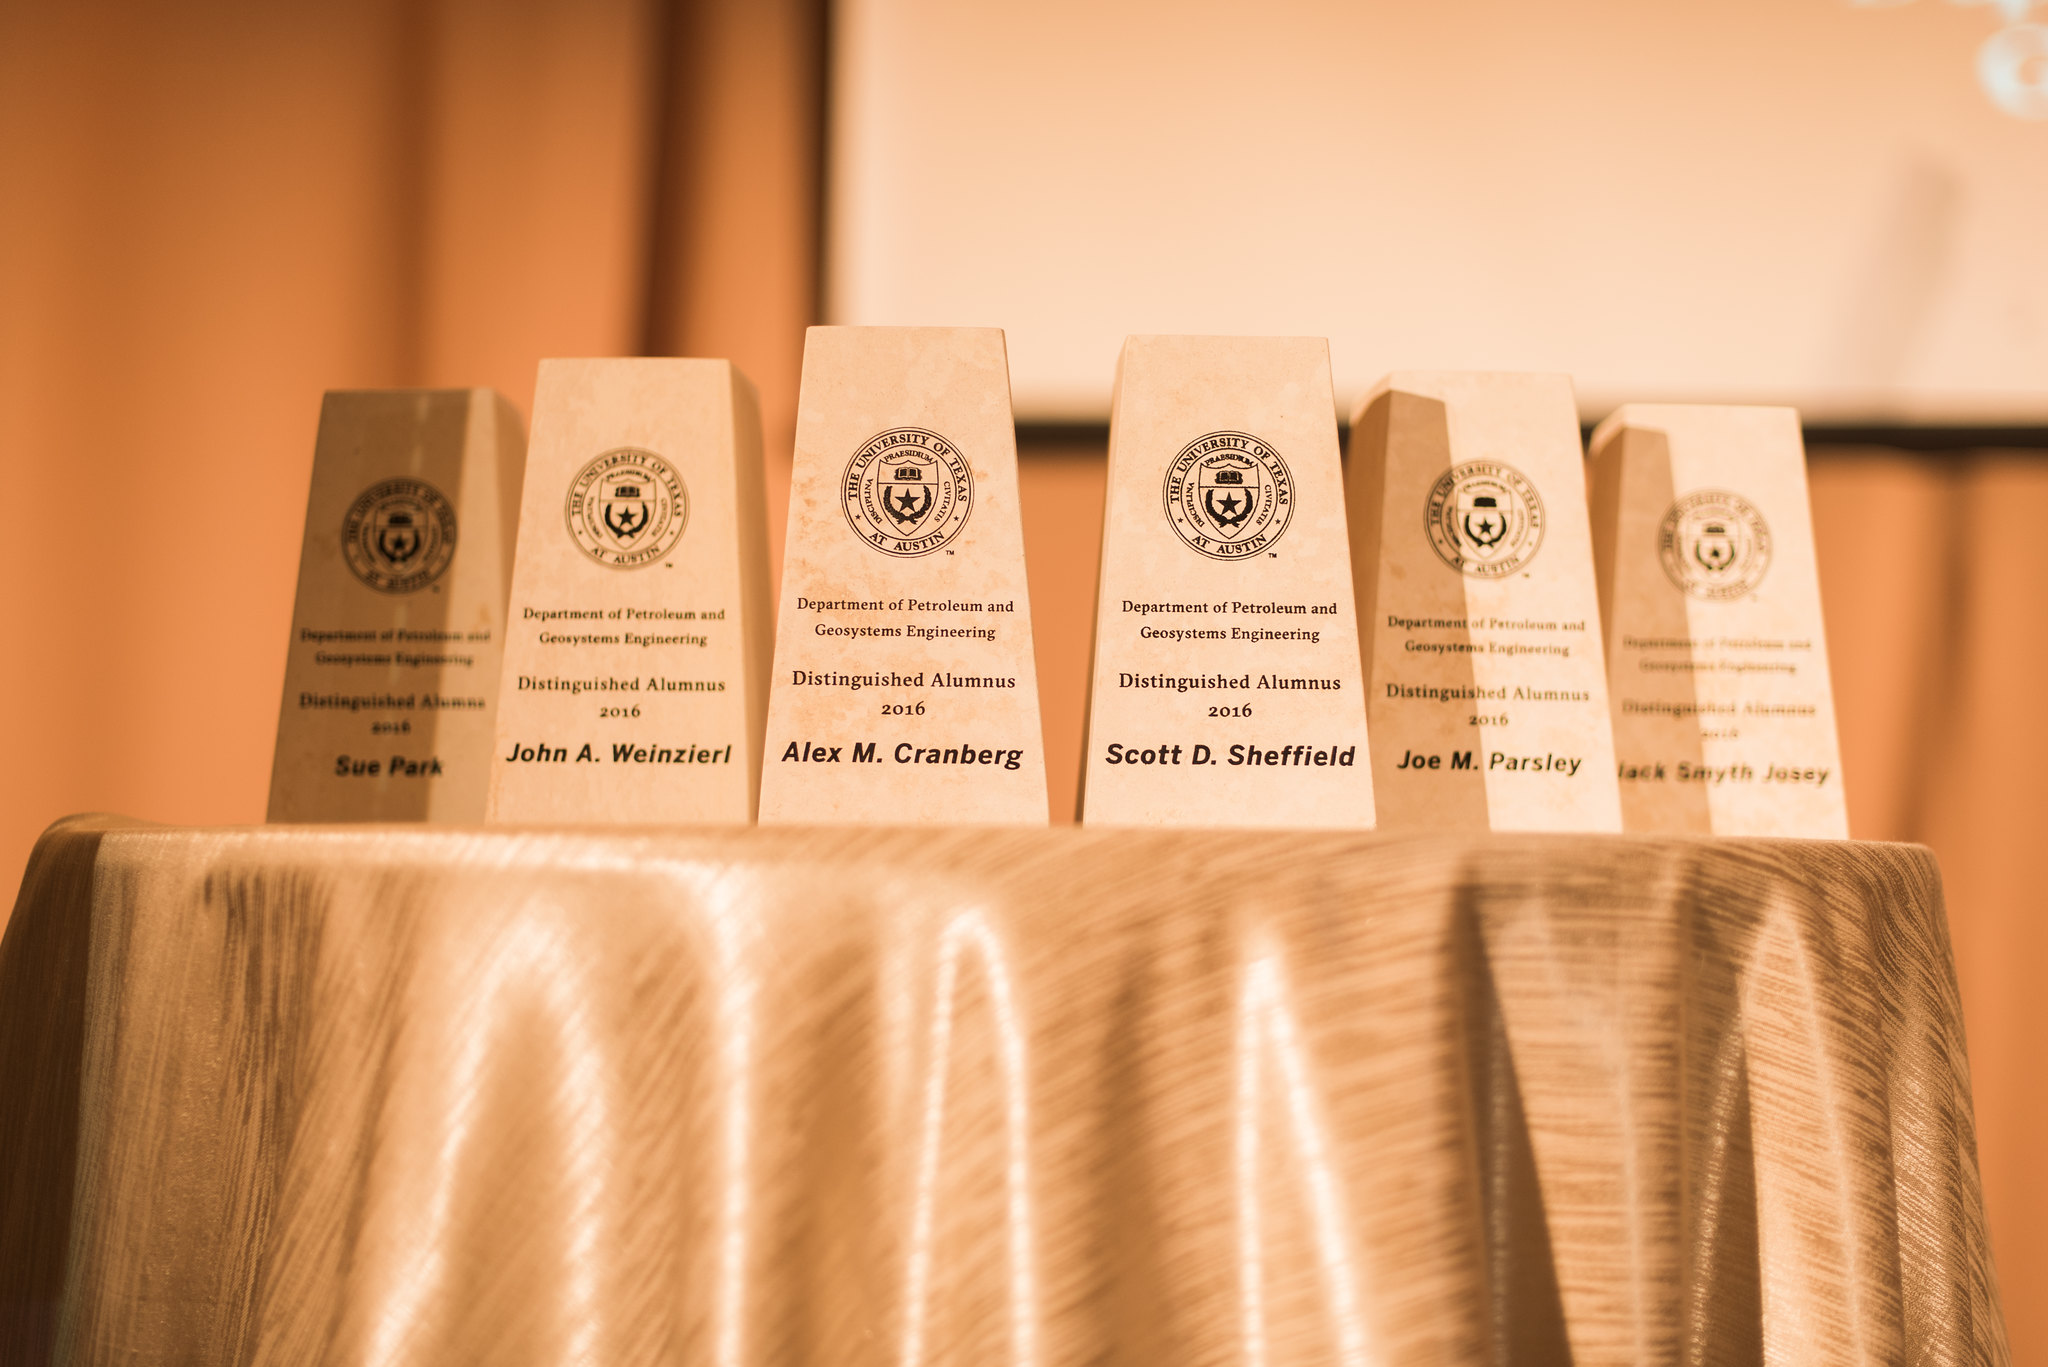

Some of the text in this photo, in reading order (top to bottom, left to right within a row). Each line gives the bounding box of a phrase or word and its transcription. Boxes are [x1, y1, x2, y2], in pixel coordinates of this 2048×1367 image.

[884, 450, 934, 464] PRAESIDIUM
[848, 434, 967, 502] THE UNIVERSITY OF TEXAS
[1170, 438, 1288, 505] THE UNIVERSITY OF TEXAS
[864, 478, 882, 524] DISCIPLINA
[934, 481, 951, 522] CIVITATIS
[1186, 482, 1205, 528] DISCIPLINA
[1256, 484, 1272, 526] CIVITATIS
[869, 531, 944, 551] AT AUSTIN
[1192, 534, 1267, 554] AT AUSTIN
[797, 597, 1014, 613] Department of Petroleum and
[1122, 600, 1338, 616] Department of Petroleum and
[524, 607, 725, 623] Department of Petroleum and
[1387, 616, 1586, 632] Department of Petroleum and
[539, 632, 708, 647] Geosystems Engineering
[814, 624, 996, 640] Geosystems Engineering
[1140, 626, 1320, 644] Geosystems Engineering
[1405, 640, 1570, 658] Geosystems Engineering
[518, 676, 726, 694] Distinguished Alumnus
[792, 670, 1016, 690] Distinguished Alumnus
[1118, 673, 1342, 692] Distinguished Alumnus
[1386, 684, 1590, 702] Distinguished Alumnus
[600, 705, 640, 718] 2016
[881, 701, 926, 716] 2016
[1208, 703, 1252, 718] 2016
[1468, 714, 1508, 727] 2016
[506, 743, 732, 764] John A. Weinzierl
[782, 741, 1024, 770] Alex M. Cranberg
[1105, 744, 1356, 766] Scott D. Sheffield
[335, 755, 444, 777] Sue Park
[1397, 750, 1582, 777] Joe M. Parsley
